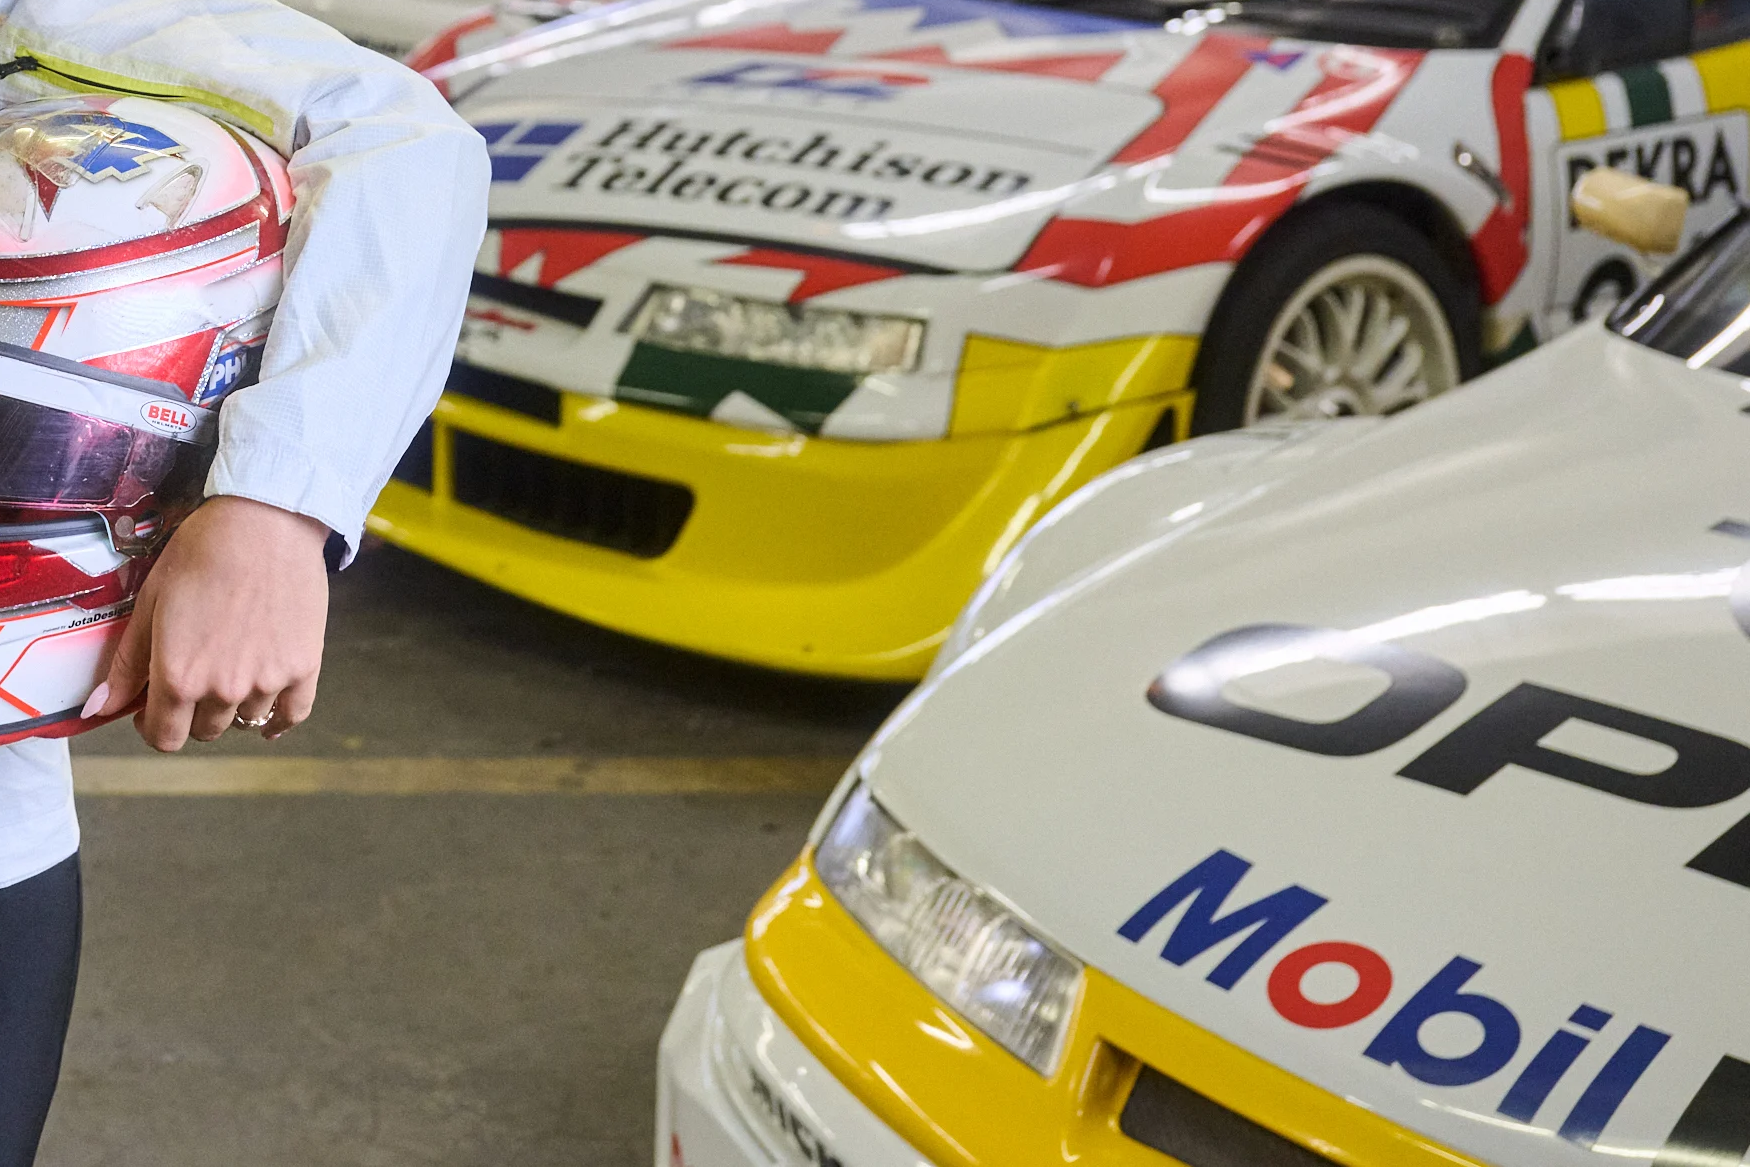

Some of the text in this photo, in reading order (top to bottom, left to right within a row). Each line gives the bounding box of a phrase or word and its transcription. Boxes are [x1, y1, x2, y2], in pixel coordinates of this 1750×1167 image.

[557, 148, 896, 221] Telecom
[596, 118, 1033, 196] Hutchison
[148, 405, 189, 428] BELL
[151, 420, 182, 431] HELMETS
[1146, 623, 1750, 890] OP
[1116, 848, 1672, 1151] Mobil
